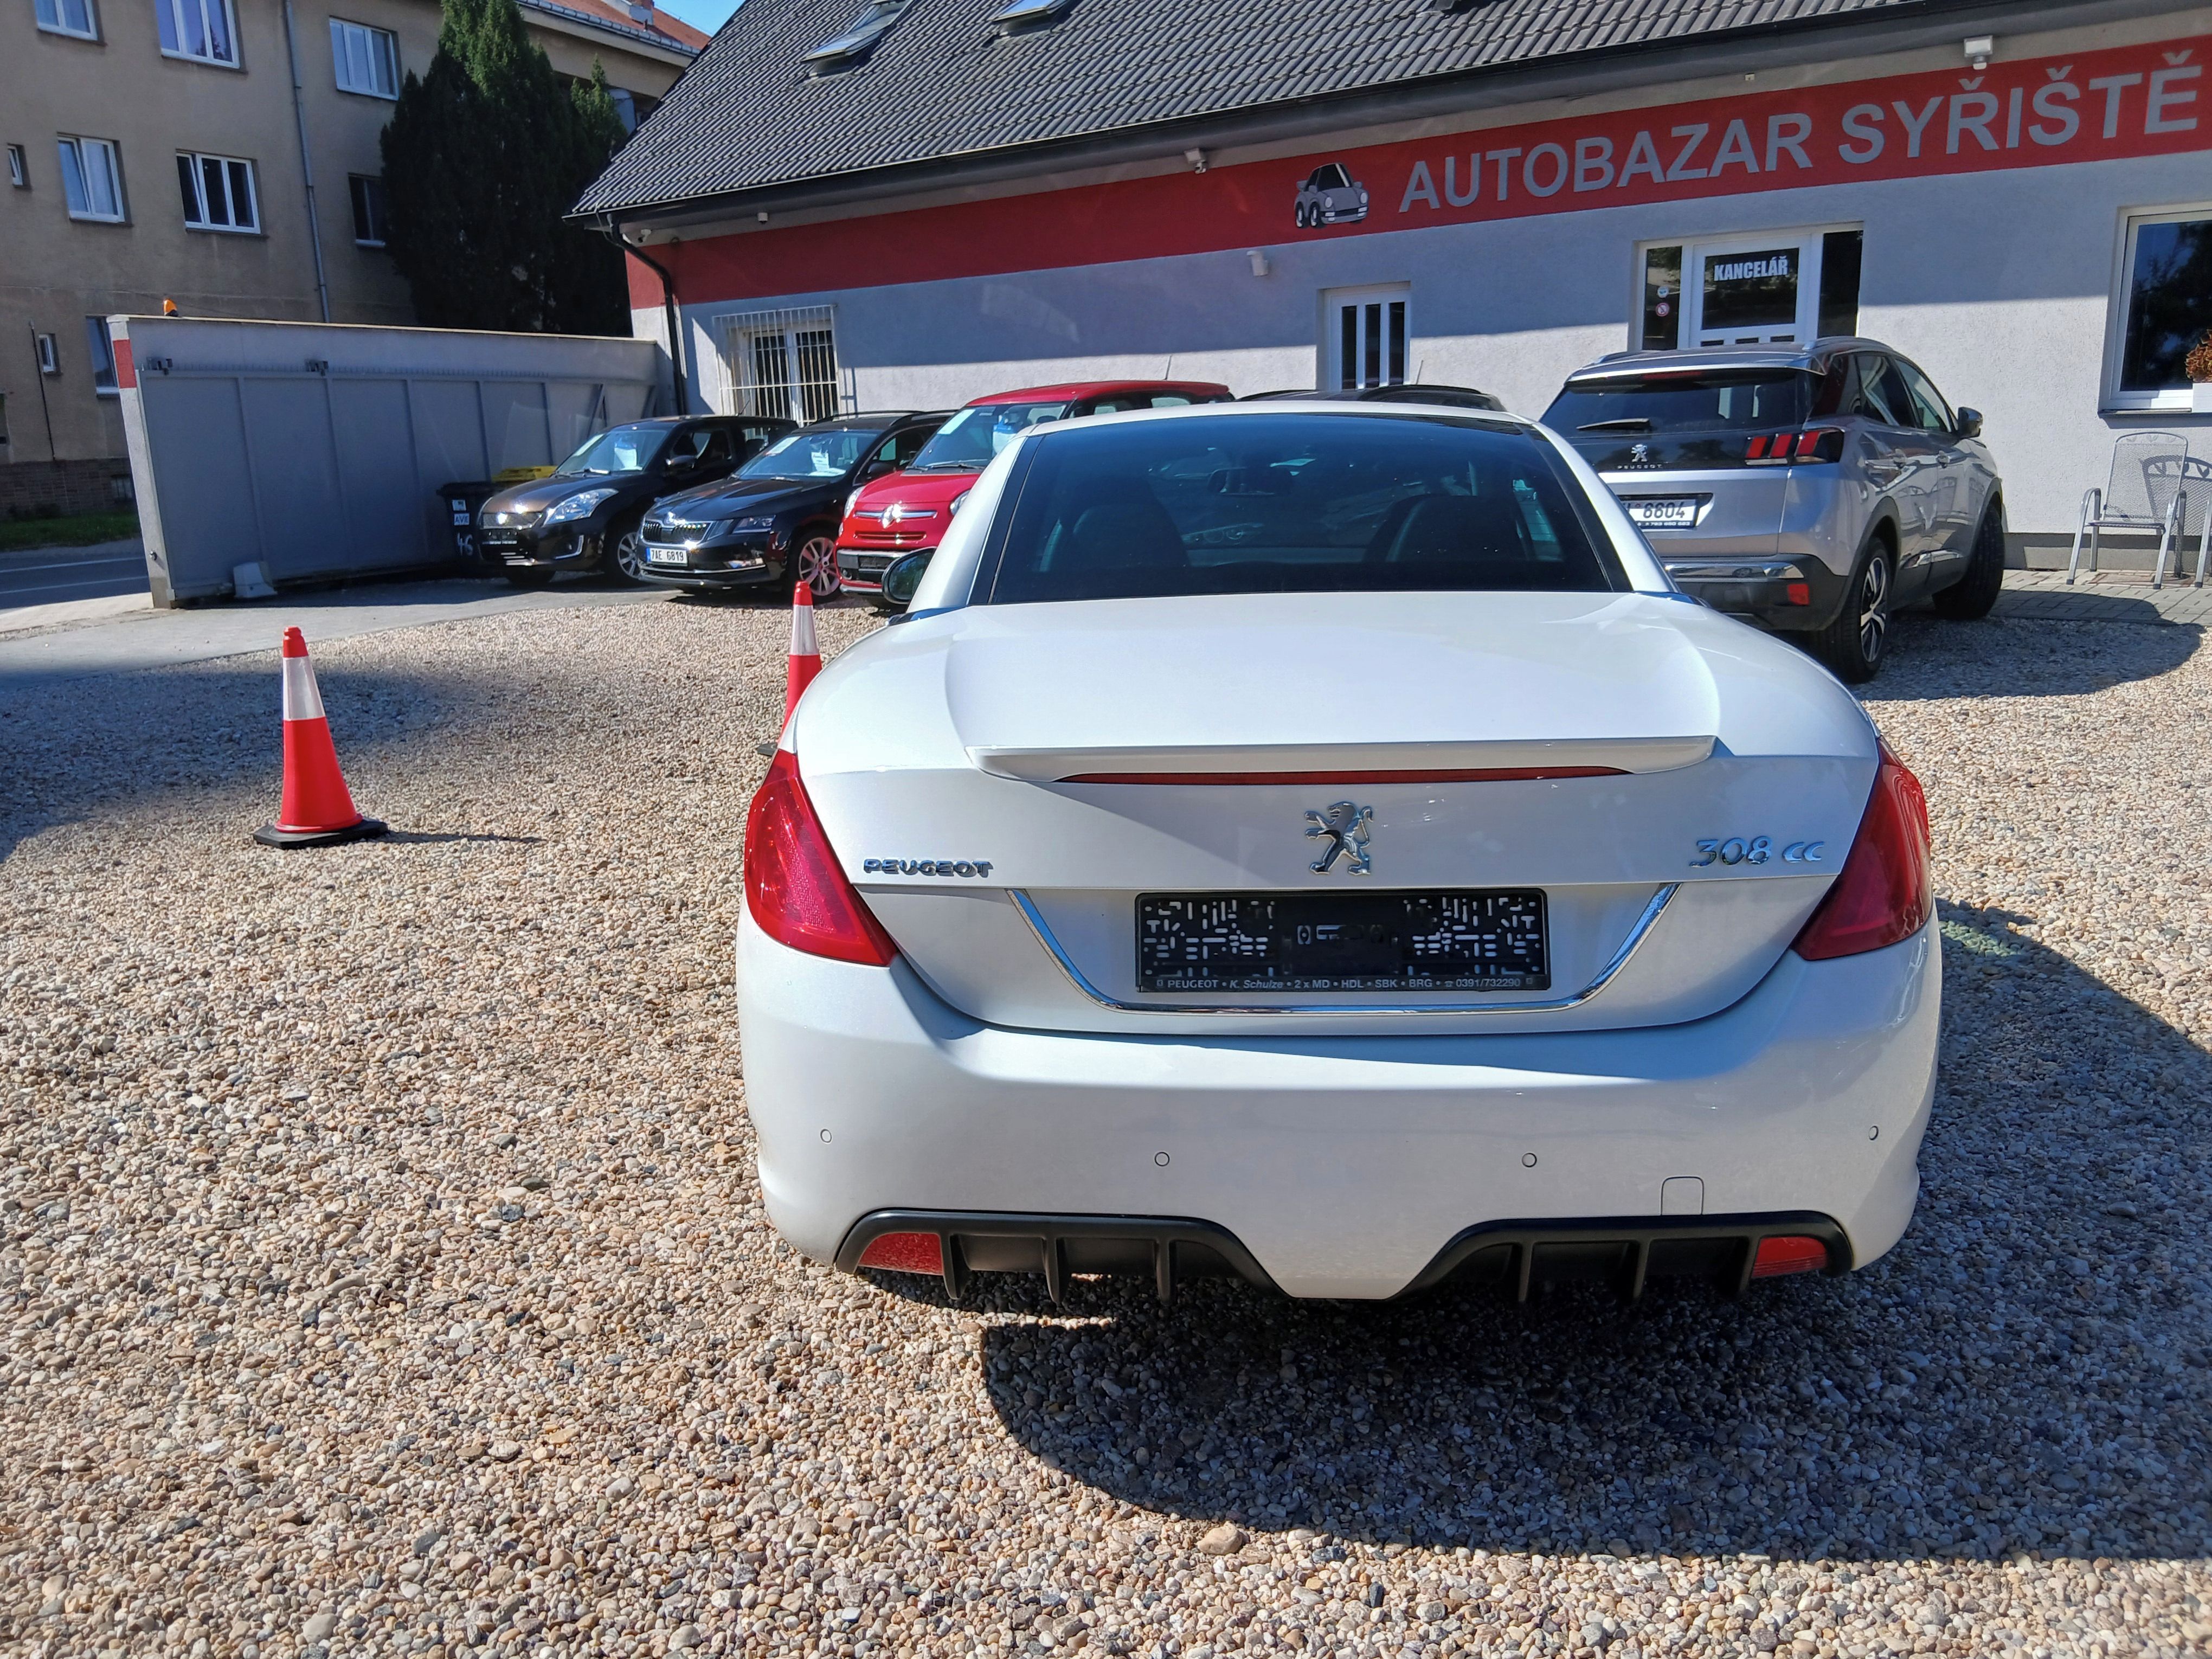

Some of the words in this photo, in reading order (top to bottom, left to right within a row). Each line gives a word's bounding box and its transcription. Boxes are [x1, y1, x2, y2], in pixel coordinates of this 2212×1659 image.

[1399, 112, 1813, 213] AUTOBAZAR
[1838, 49, 2203, 164] SYŘIŠTĚ
[1714, 256, 1789, 281] KANCELÁŘ
[1643, 501, 1685, 518] 6604
[652, 550, 662, 560] 7AE
[667, 551, 684, 561] 6819
[1689, 836, 1771, 867] 308
[864, 859, 994, 878] PEUGEOT
[1168, 980, 1218, 988] PEUGEOT
[1230, 980, 1240, 988] K.
[1243, 980, 1283, 989] Schulze
[1313, 979, 1329, 988] MD
[1341, 979, 1364, 988] HDL
[1375, 979, 1397, 988] SBK
[1409, 979, 1432, 987] BRG
[1456, 979, 1520, 987] 0391/732290
